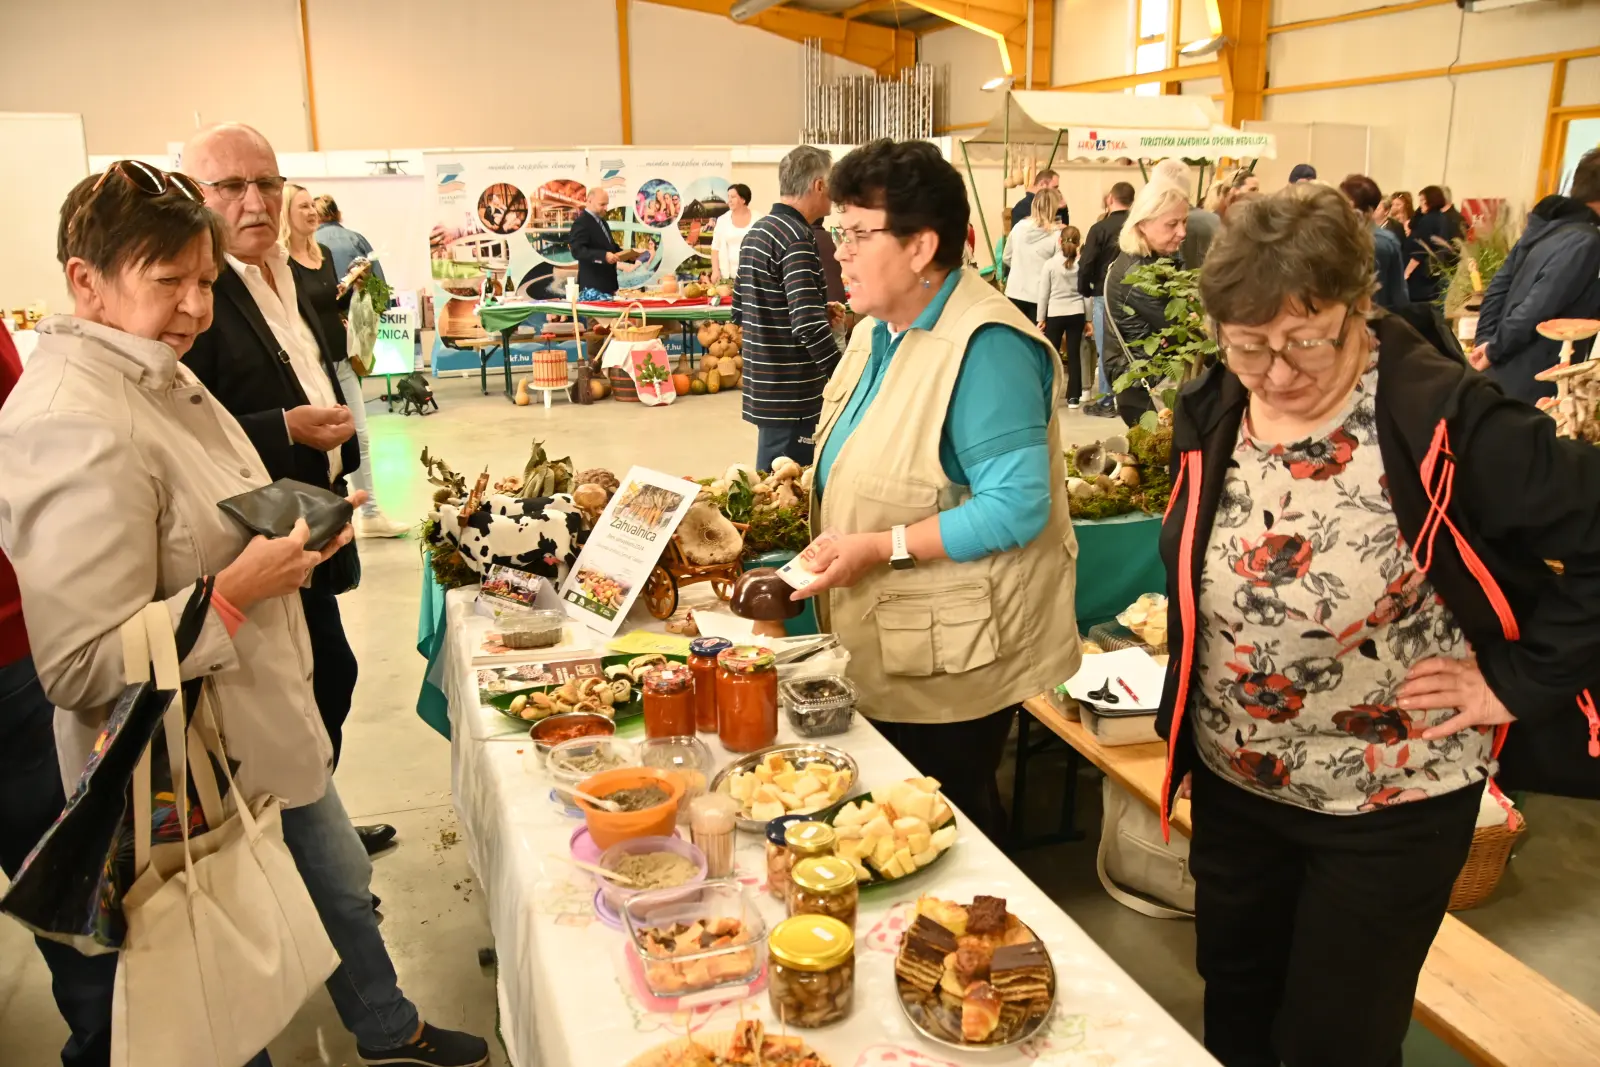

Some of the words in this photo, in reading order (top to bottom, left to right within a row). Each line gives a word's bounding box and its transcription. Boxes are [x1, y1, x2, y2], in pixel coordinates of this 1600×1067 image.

[1077, 139, 1128, 151] HRVATSKA
[1177, 136, 1210, 147] ZAJEDNICA
[379, 313, 407, 324] SKIH
[610, 517, 657, 542] Zahvalnica
[800, 548, 817, 563] 10
